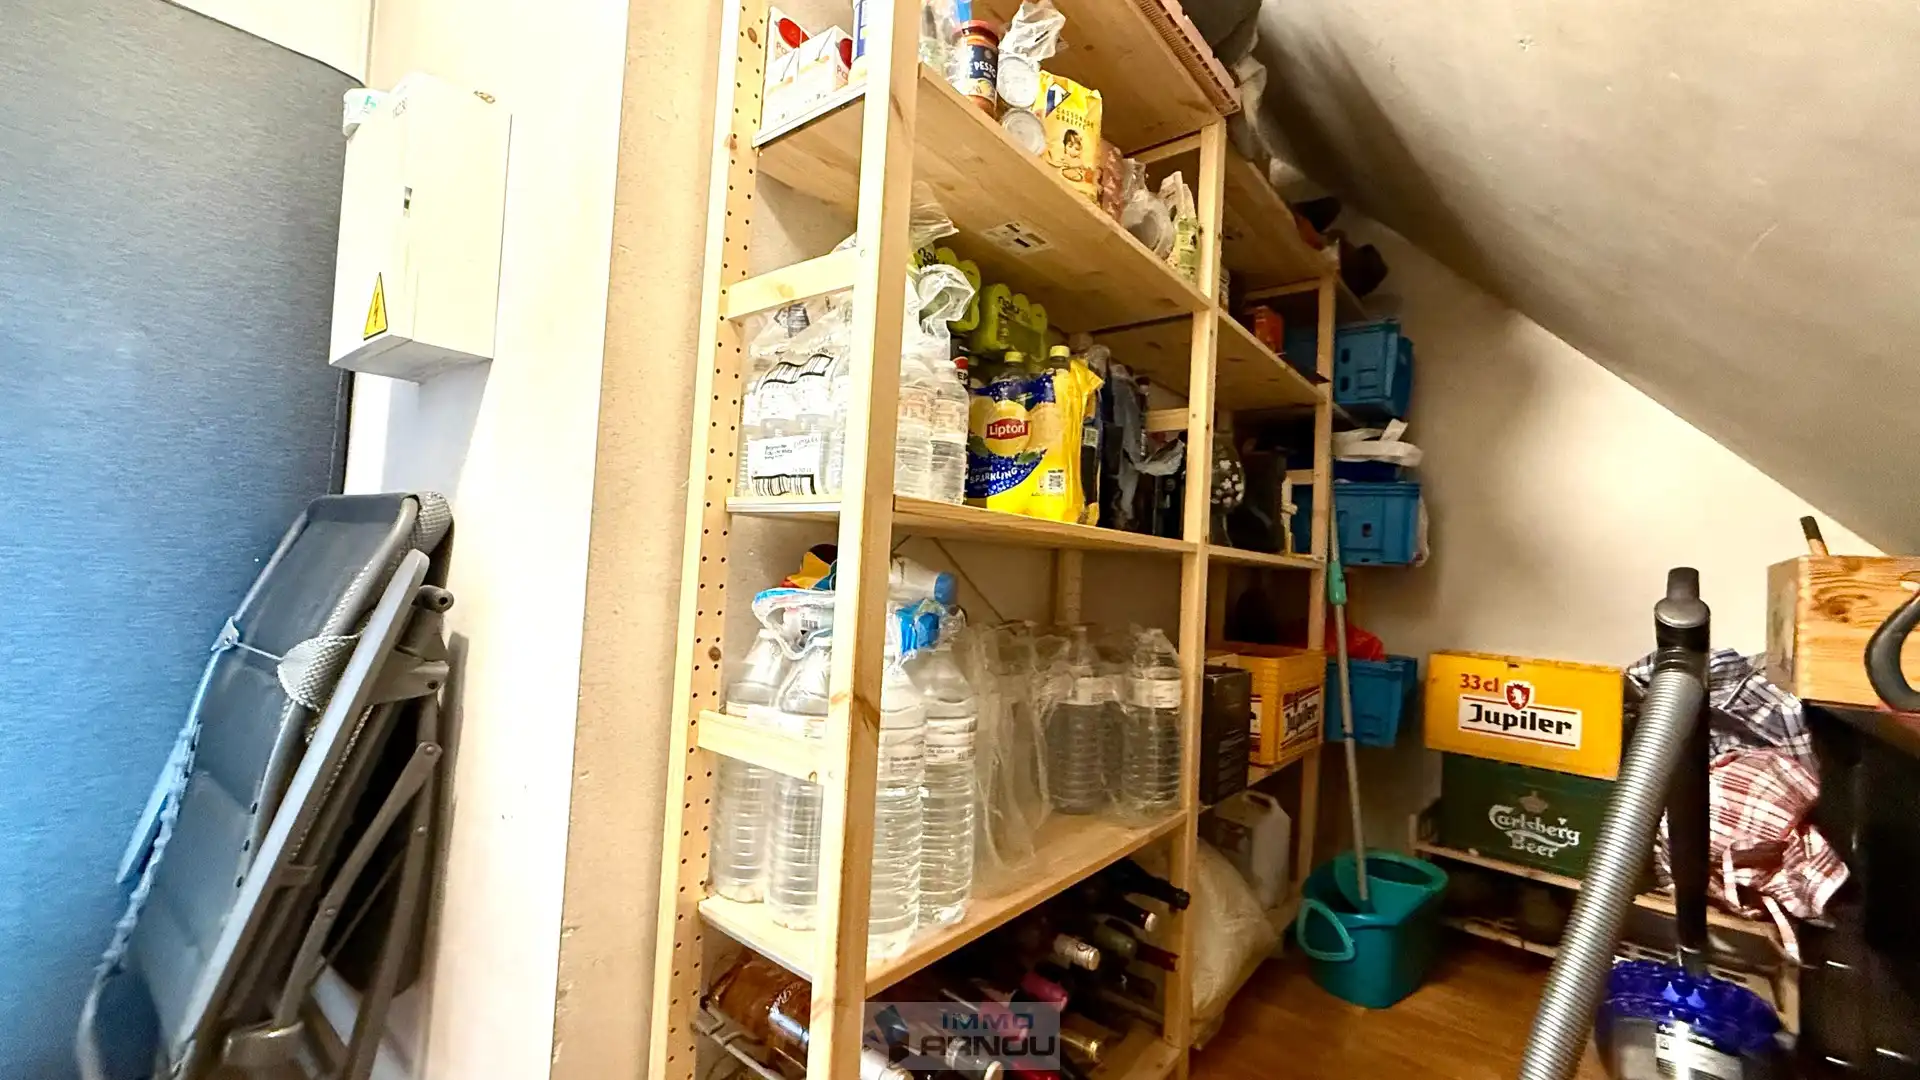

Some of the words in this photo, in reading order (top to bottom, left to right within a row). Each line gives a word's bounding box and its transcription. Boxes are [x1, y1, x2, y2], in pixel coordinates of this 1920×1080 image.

[989, 423, 1025, 437] Lipton
[969, 467, 1018, 484] SPARKLING
[1460, 673, 1499, 693] 33cl
[1468, 703, 1573, 735] Jupiler
[1488, 804, 1581, 848] Carlsberg
[1510, 833, 1559, 857] Beer
